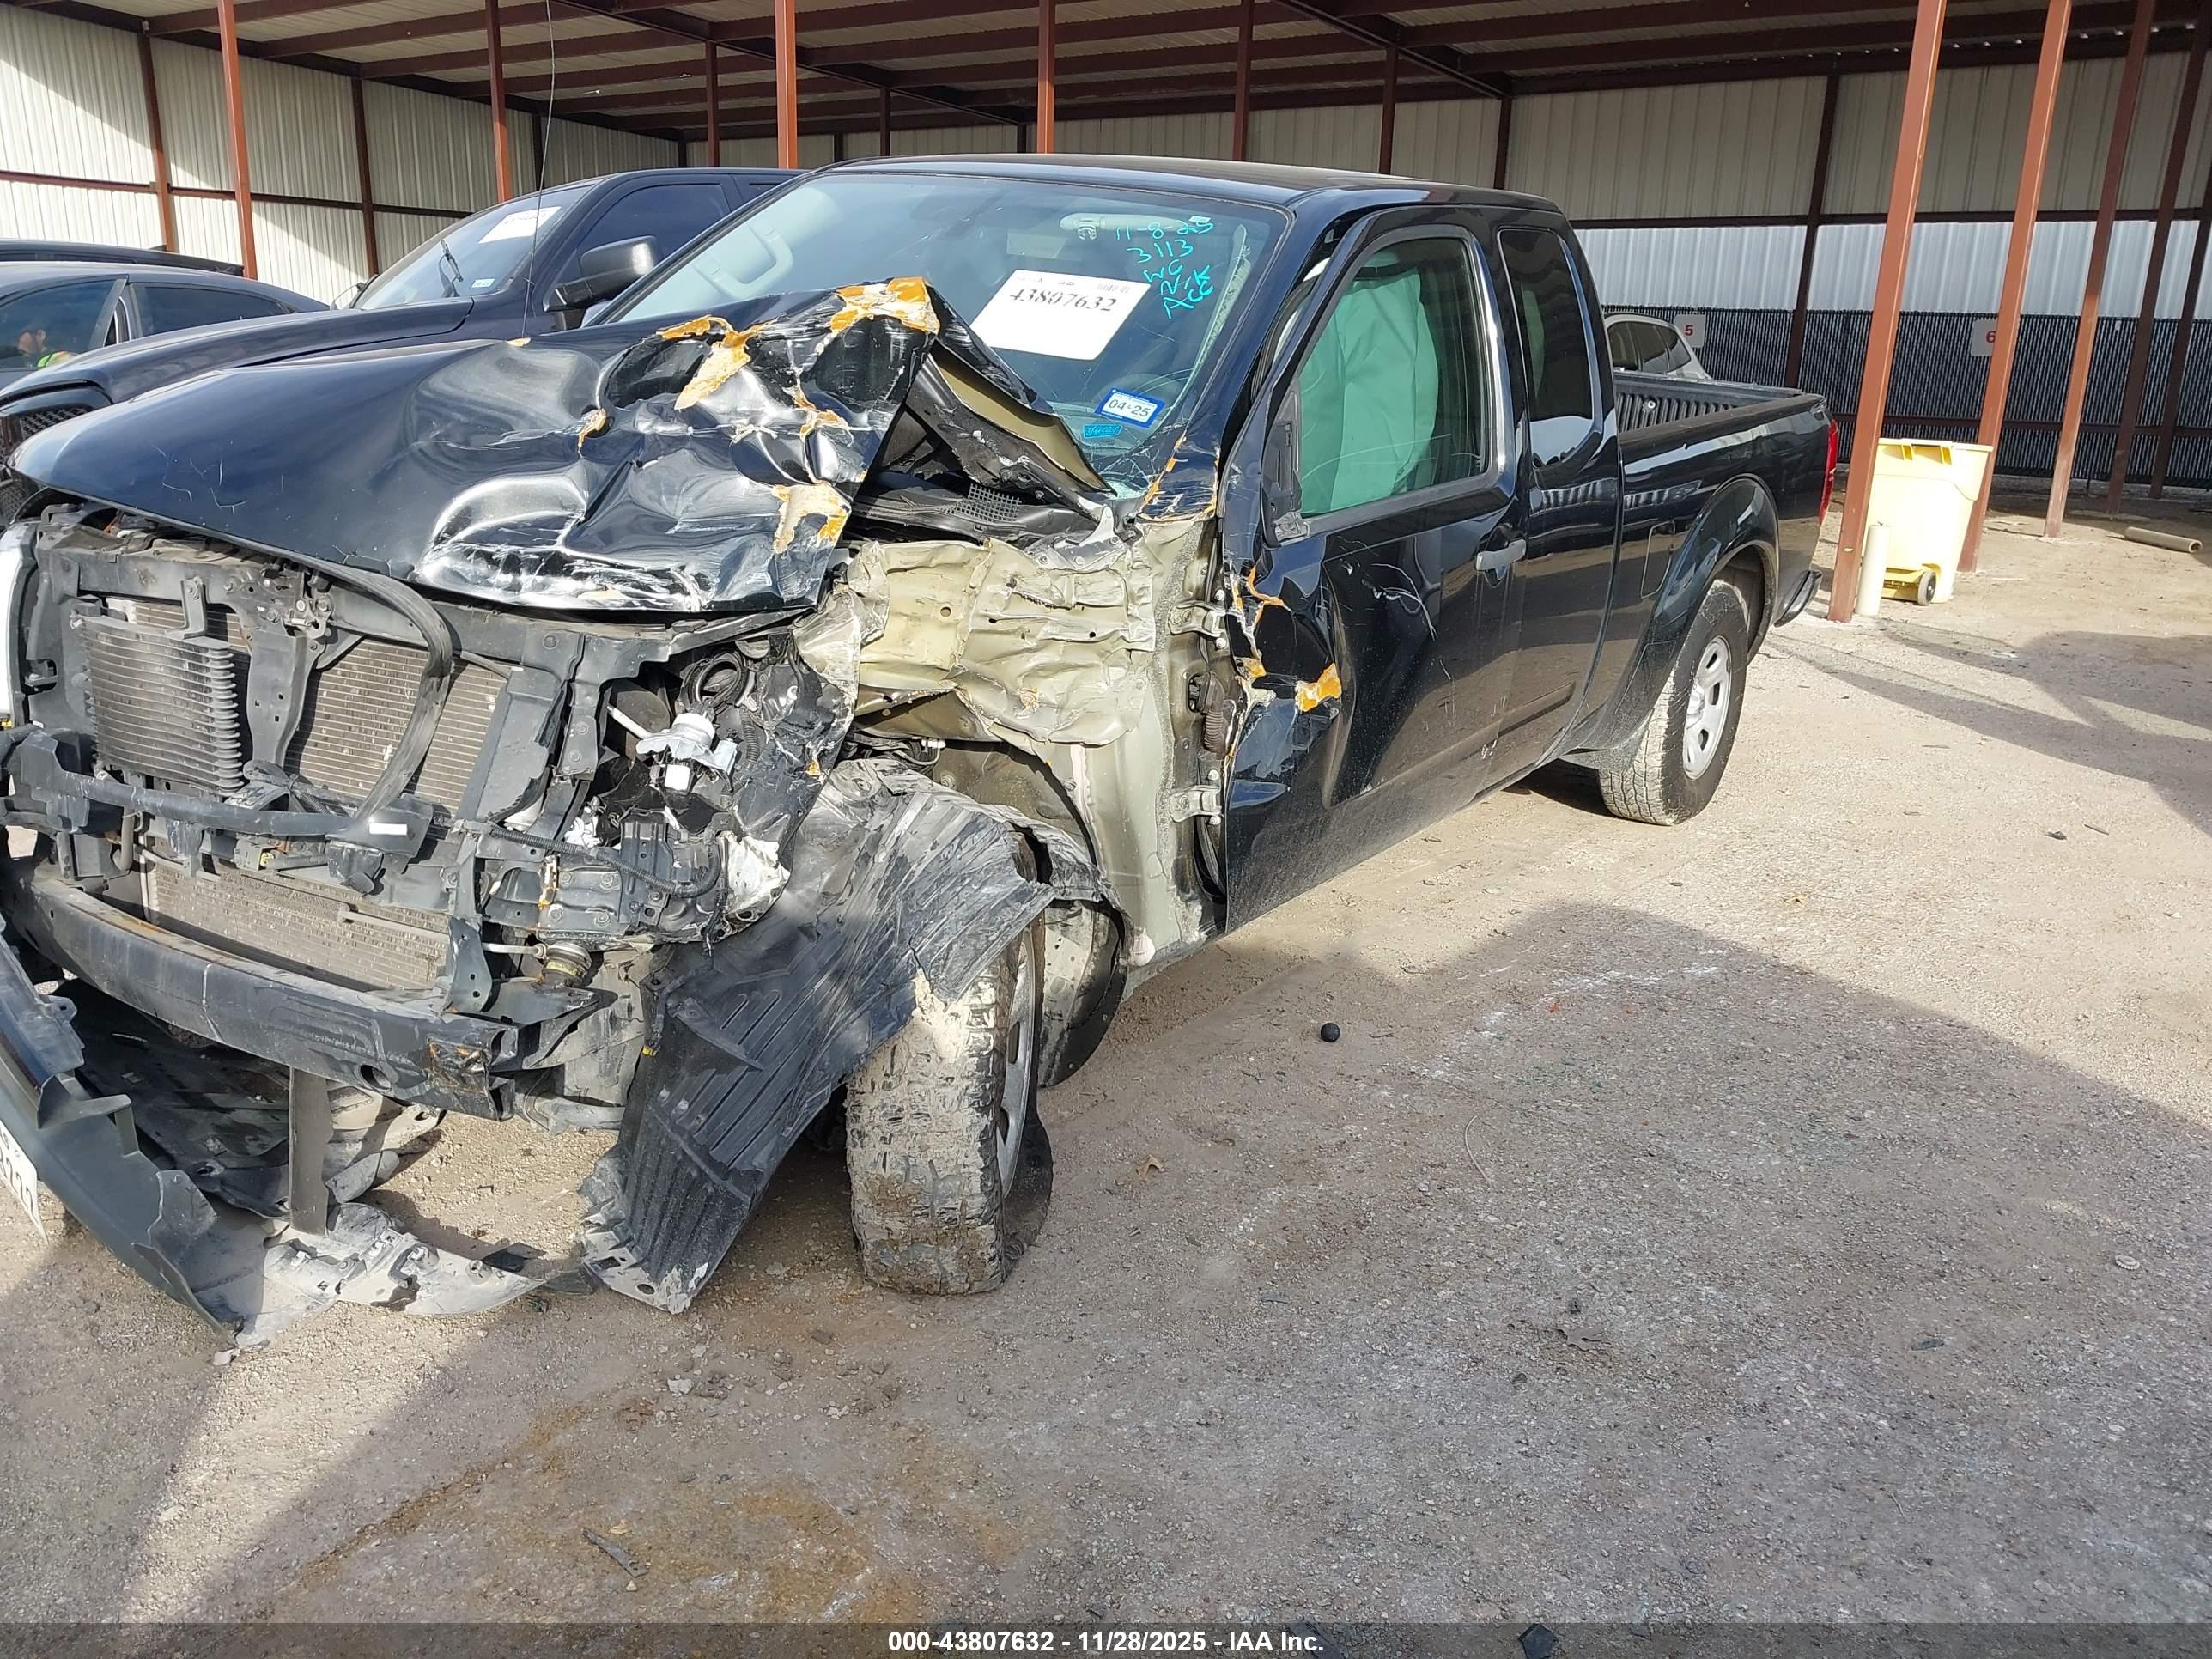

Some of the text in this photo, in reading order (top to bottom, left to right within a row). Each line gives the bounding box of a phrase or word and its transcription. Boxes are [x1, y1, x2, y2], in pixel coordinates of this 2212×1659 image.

[1127, 239, 1194, 264] 3113
[1010, 288, 1117, 312] 43807632
[1685, 325, 1693, 336] 5
[1985, 330, 1996, 343] 6
